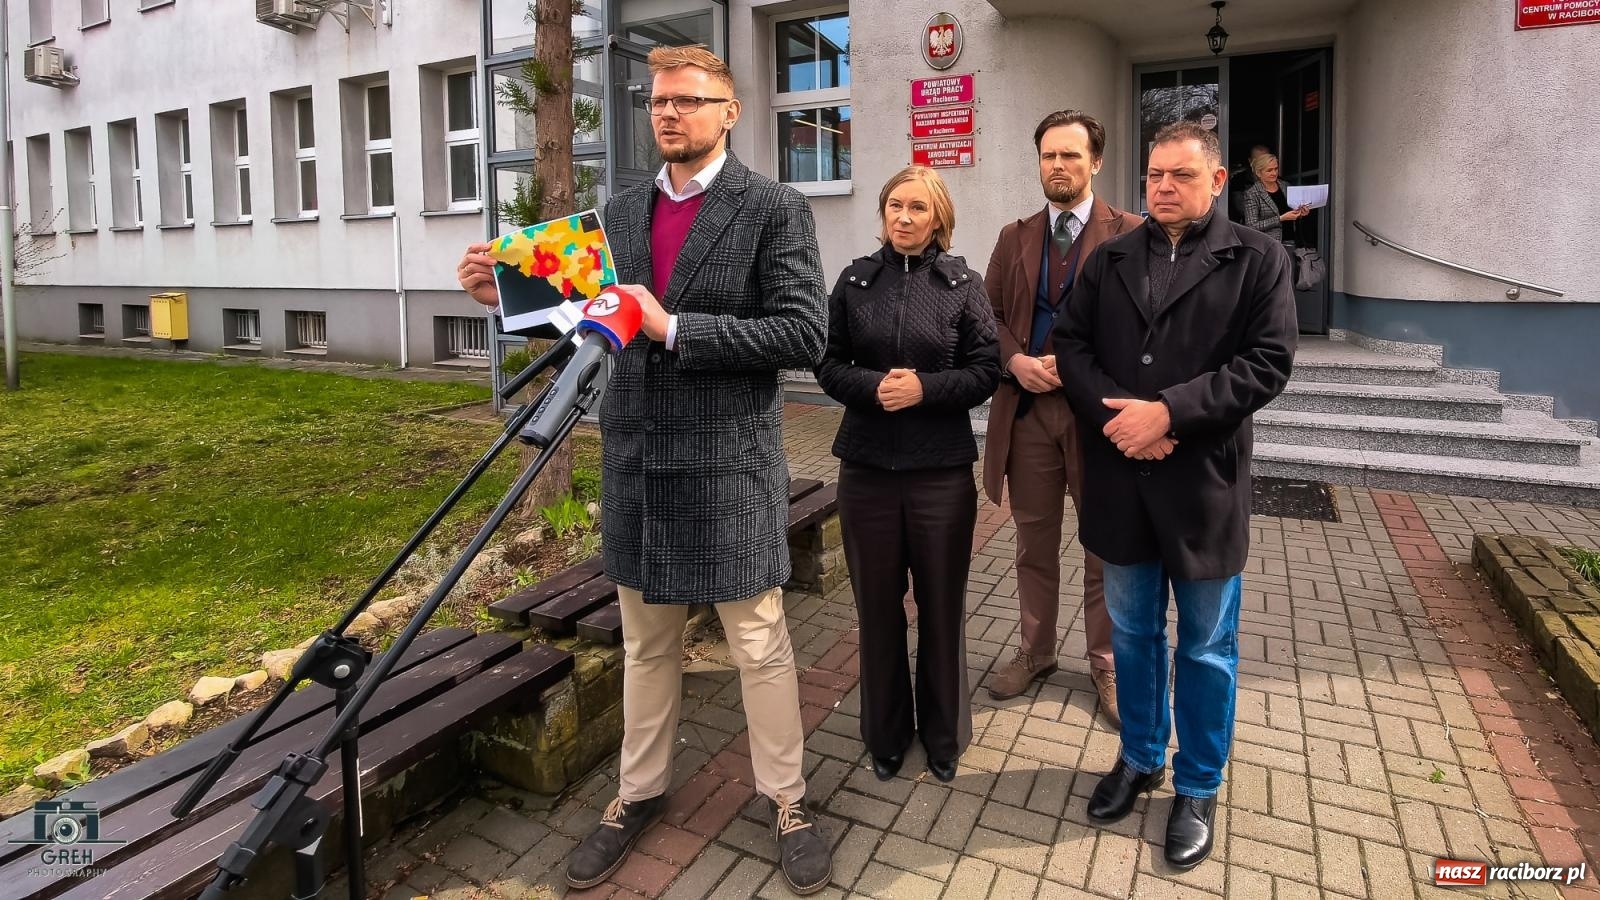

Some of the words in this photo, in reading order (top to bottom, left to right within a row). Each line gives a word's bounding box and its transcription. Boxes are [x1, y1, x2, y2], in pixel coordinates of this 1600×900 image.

[1522, 4, 1562, 13] CENTRUM
[1564, 0, 1599, 9] POMOCY
[924, 78, 960, 88] POWIATOWY
[921, 88, 941, 96] URZĄD
[914, 143, 938, 151] CENTRUM
[939, 140, 972, 149] AKTYWIZACJI
[928, 150, 959, 158] ZAWODOWEJ
